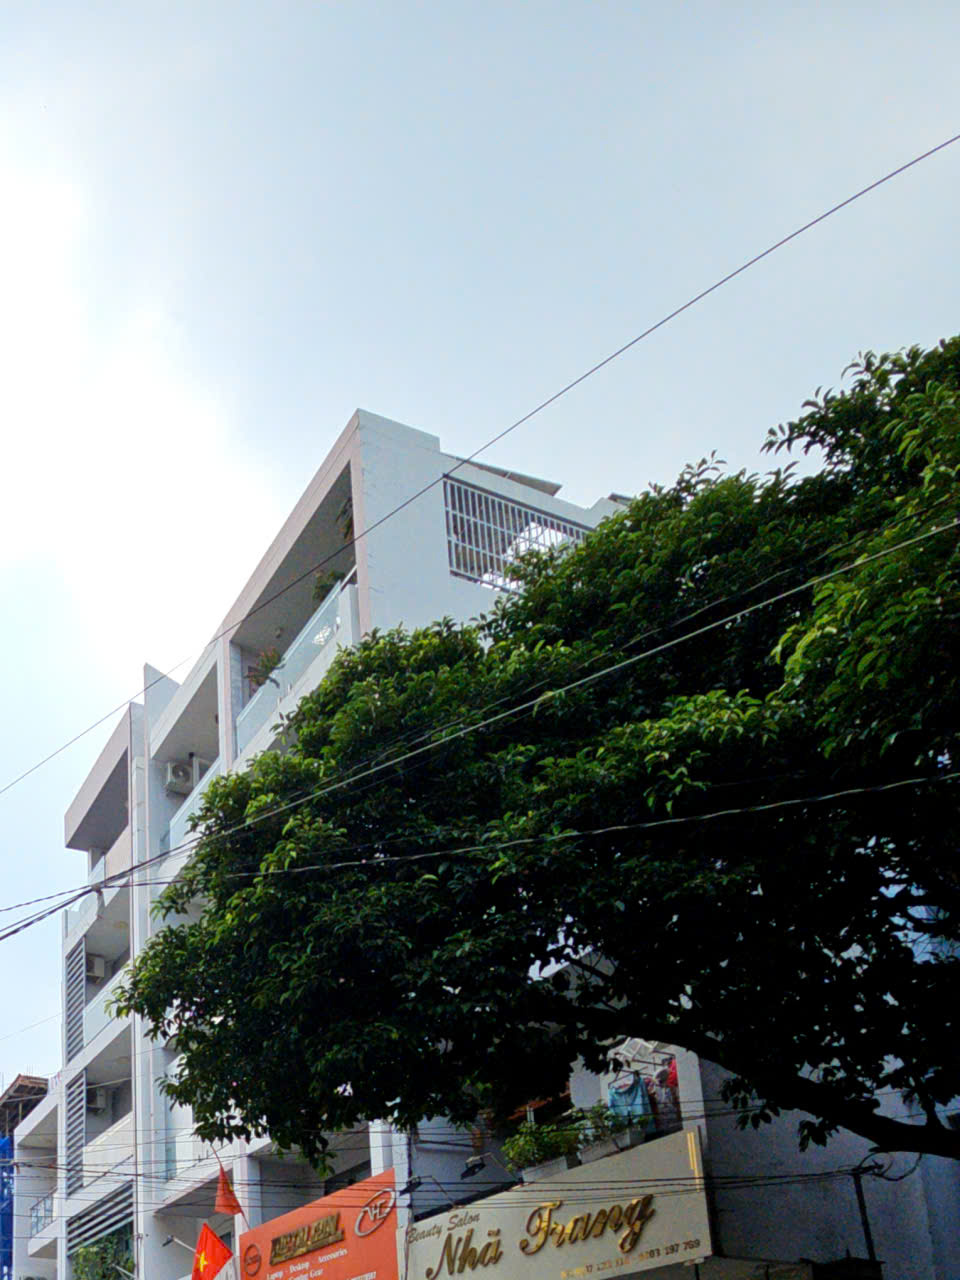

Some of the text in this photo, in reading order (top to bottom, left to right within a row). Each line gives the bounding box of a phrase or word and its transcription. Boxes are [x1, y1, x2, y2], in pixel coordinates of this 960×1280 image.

[408, 1211, 480, 1244] Beauty Salon
[519, 1193, 656, 1255] Trang
